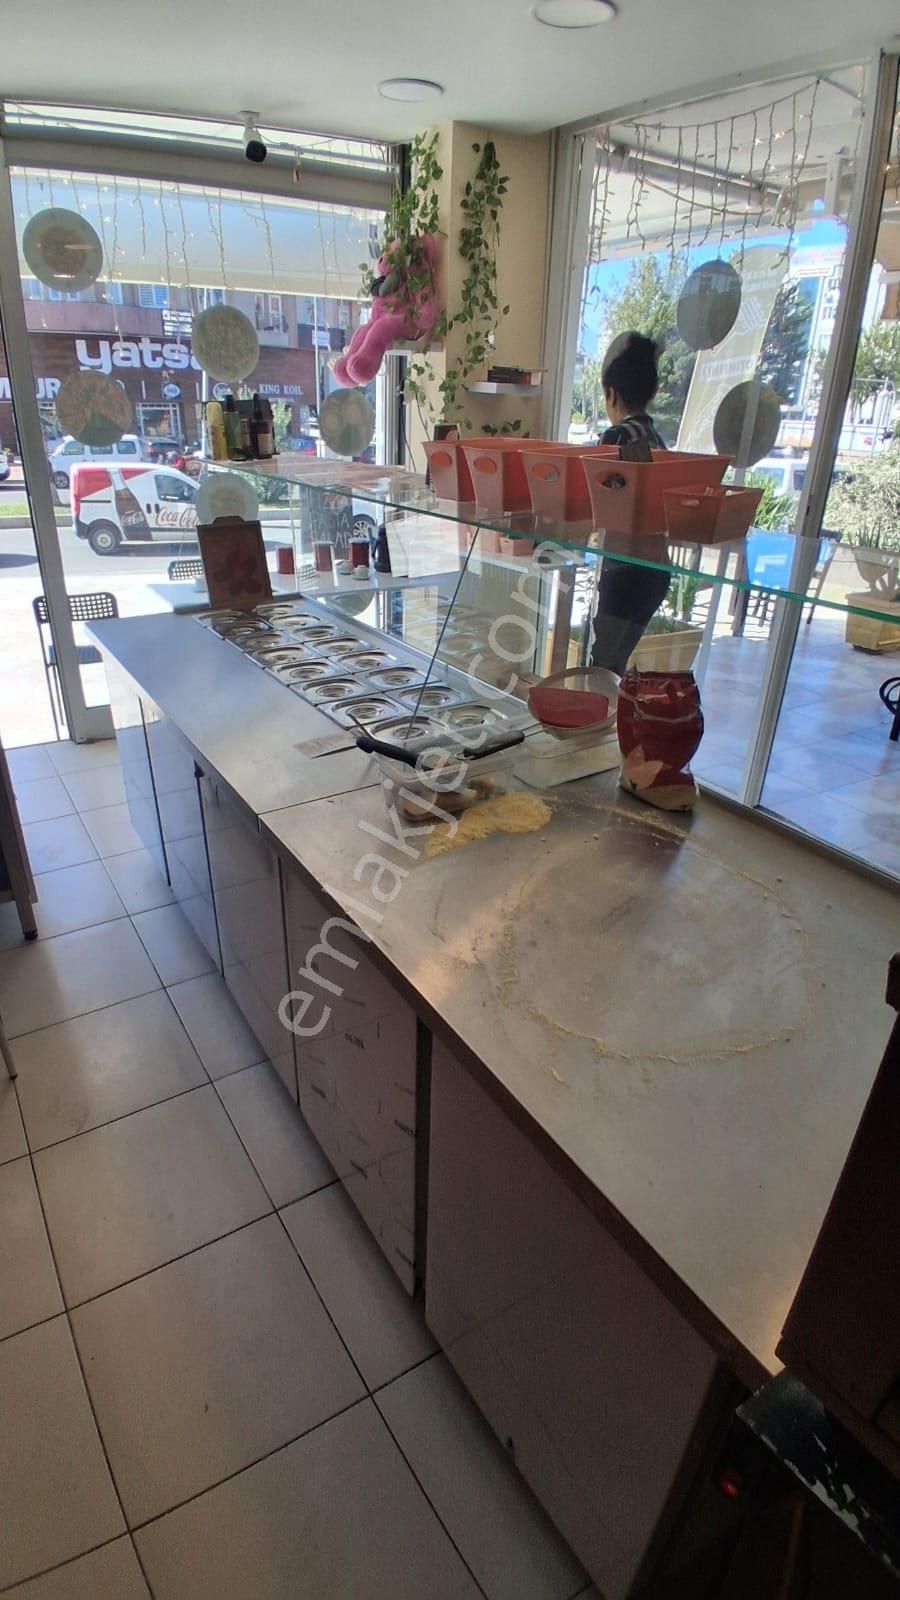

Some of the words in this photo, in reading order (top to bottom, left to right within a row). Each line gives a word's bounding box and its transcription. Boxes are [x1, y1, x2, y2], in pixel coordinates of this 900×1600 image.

[75, 337, 203, 375] yats
[258, 383, 280, 395] KING
[283, 384, 304, 396] KOIL
[312, 511, 350, 529] PATA
